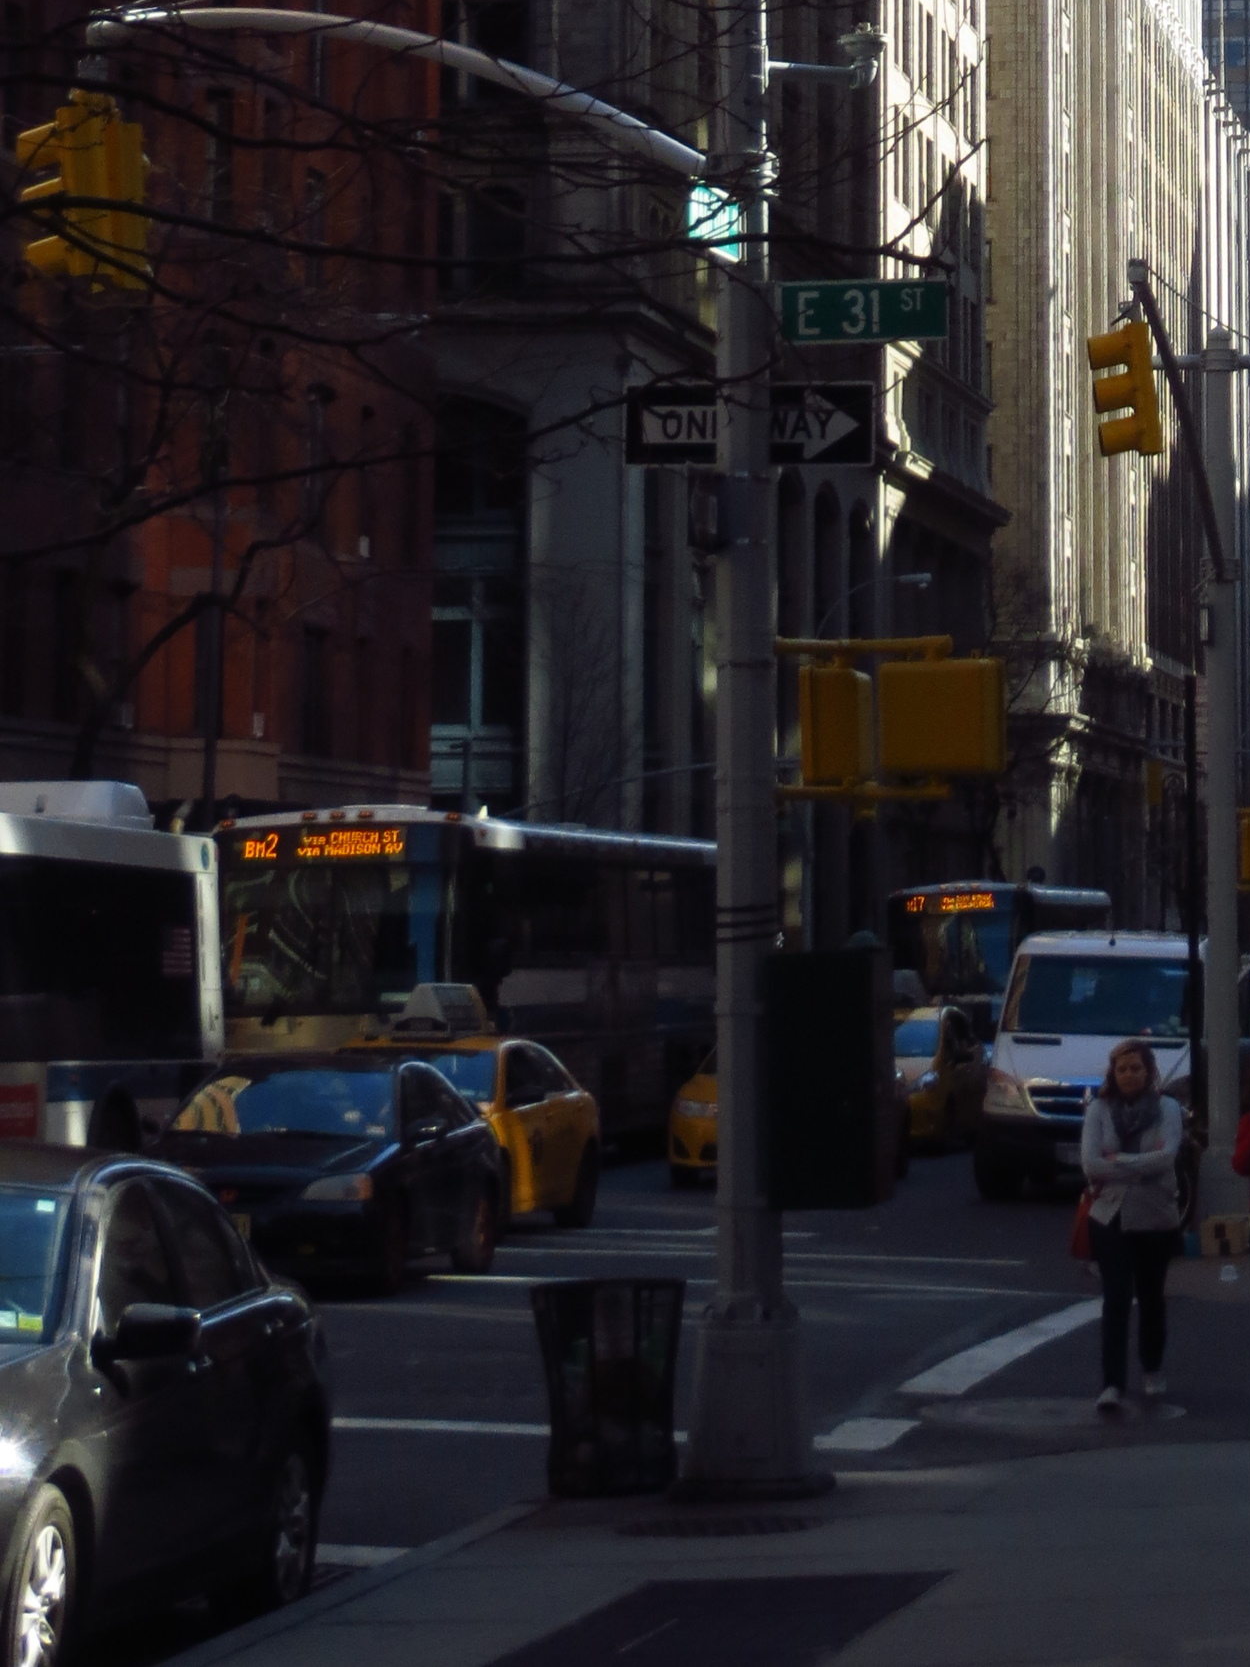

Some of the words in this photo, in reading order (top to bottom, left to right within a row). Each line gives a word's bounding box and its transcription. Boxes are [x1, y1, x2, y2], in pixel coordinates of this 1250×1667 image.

[797, 290, 822, 336] E
[841, 288, 881, 335] 31
[900, 287, 925, 313] ST
[661, 410, 717, 440] ON
[244, 832, 280, 859] BM2
[297, 846, 321, 857] VIA
[324, 842, 381, 857] MADISON
[384, 841, 404, 855] AV
[330, 830, 379, 844] CHURCH
[383, 829, 400, 843] ST
